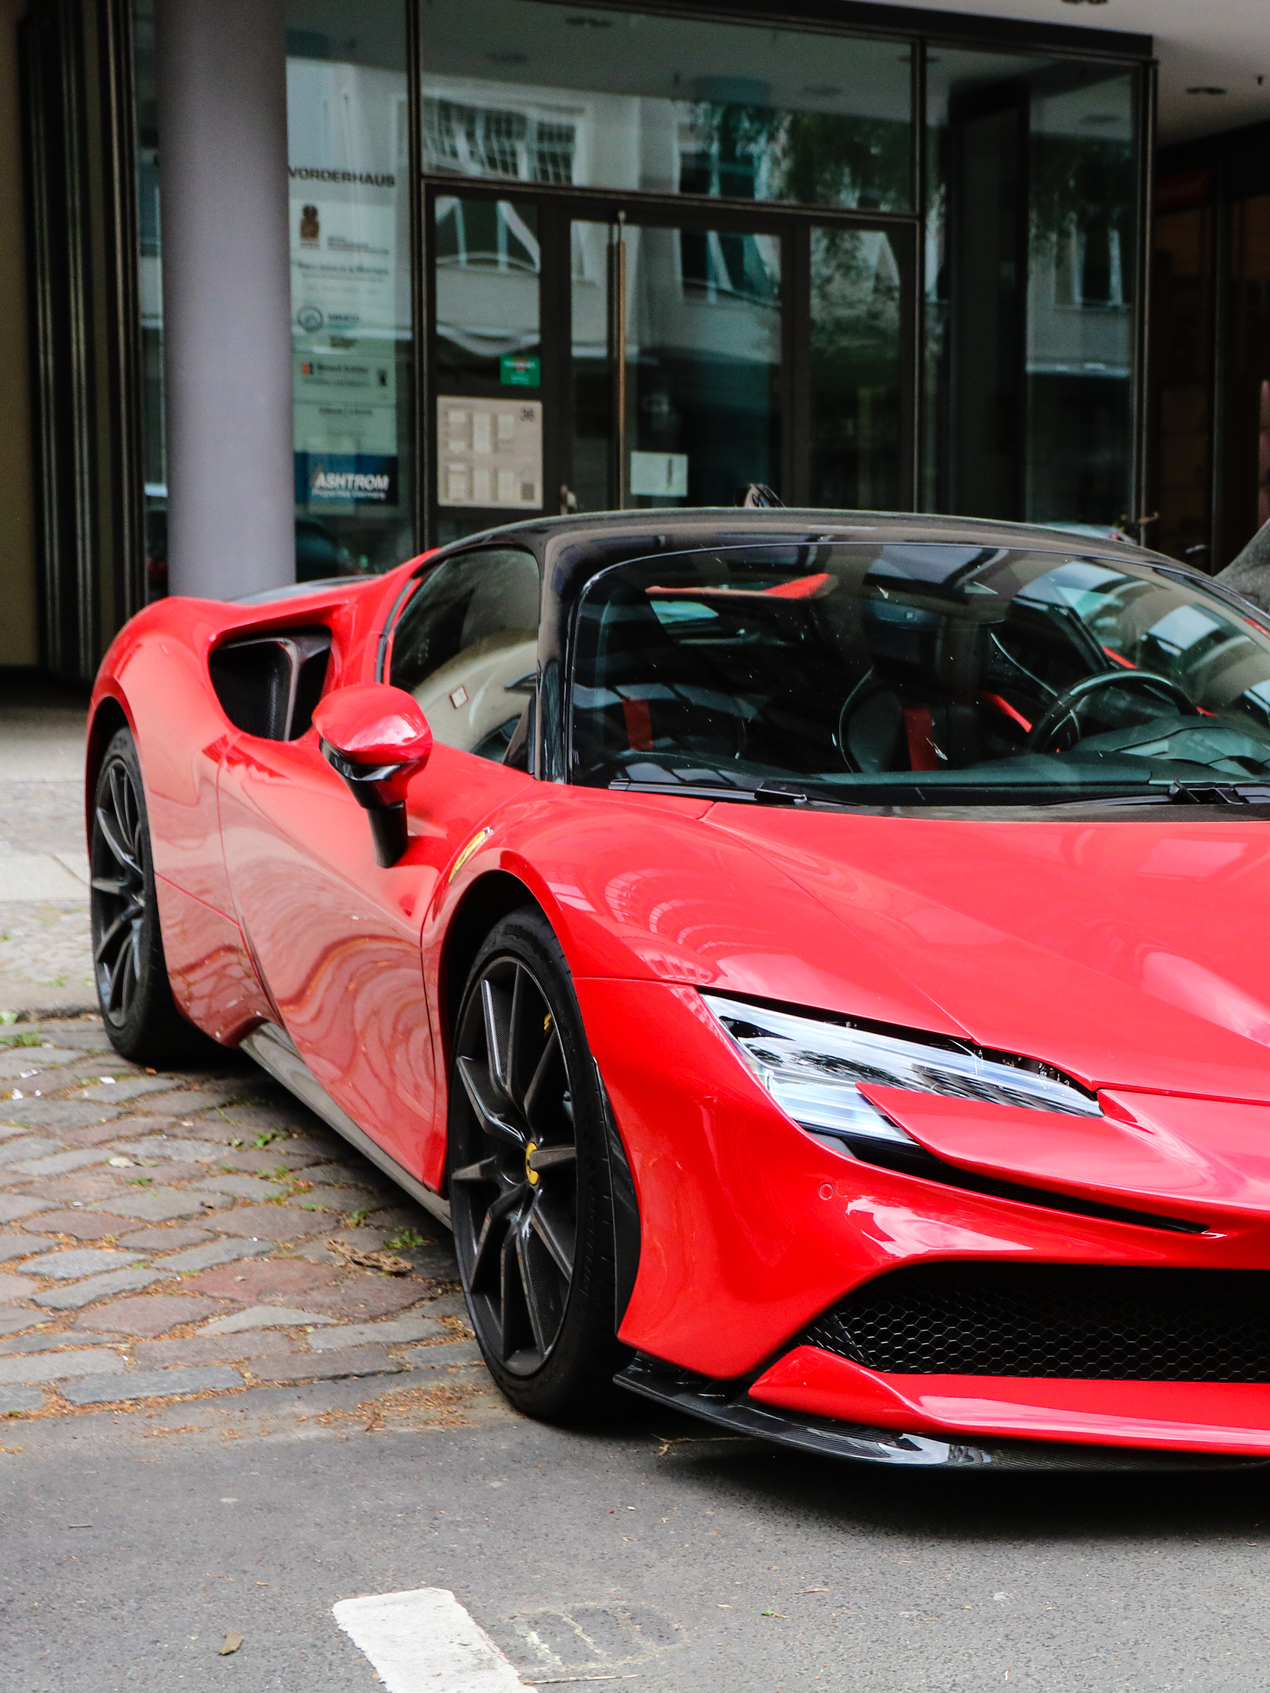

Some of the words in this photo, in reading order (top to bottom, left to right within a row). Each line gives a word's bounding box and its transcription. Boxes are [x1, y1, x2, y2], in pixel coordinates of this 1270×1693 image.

[288, 166, 395, 188] VORDERHAUS
[519, 407, 535, 422] 36
[313, 471, 390, 491] ASHTROM
